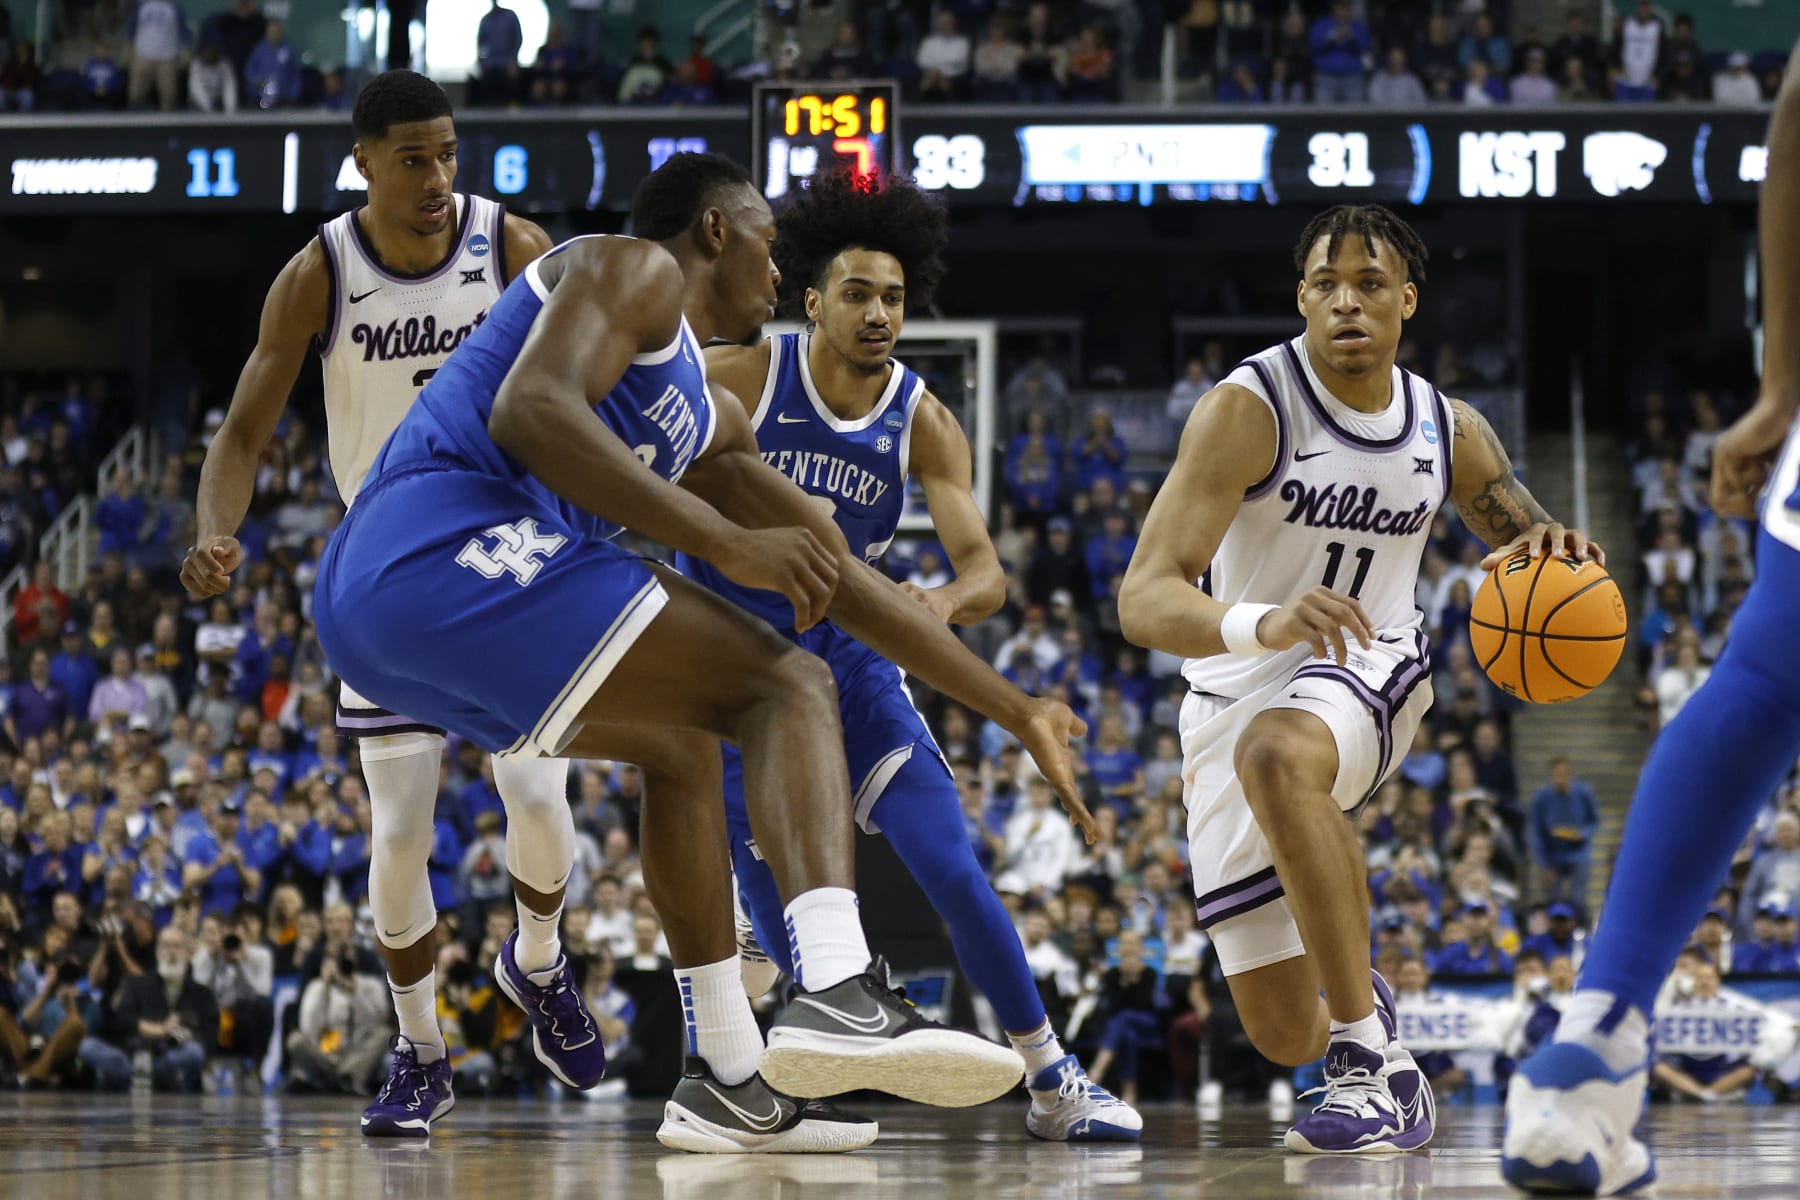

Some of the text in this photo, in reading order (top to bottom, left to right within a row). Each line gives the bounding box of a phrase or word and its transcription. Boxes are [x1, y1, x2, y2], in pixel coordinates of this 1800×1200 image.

[785, 94, 886, 138] 17:51
[186, 148, 239, 197] 11
[493, 145, 529, 194] 6
[912, 134, 986, 190] 33
[1307, 132, 1375, 187] 31
[1459, 131, 1566, 198] KST
[352, 308, 488, 362] Wildca
[876, 437, 892, 452] SEC
[1280, 479, 1432, 537] Wildcats
[455, 516, 568, 587] UK
[1321, 541, 1375, 600] 11
[1401, 1012, 1468, 1040] ENSE
